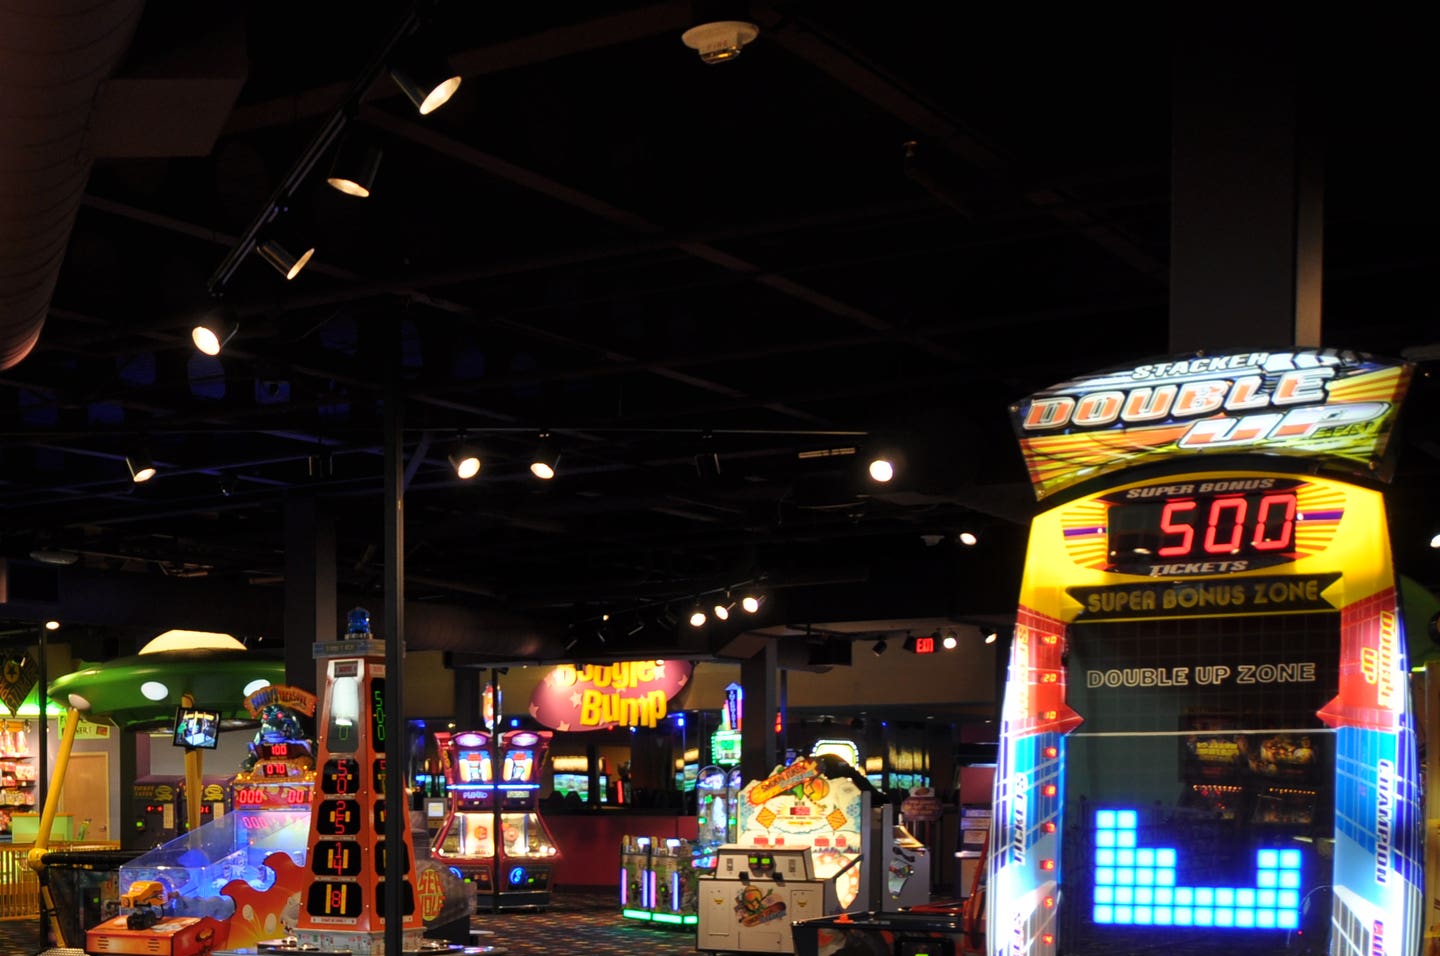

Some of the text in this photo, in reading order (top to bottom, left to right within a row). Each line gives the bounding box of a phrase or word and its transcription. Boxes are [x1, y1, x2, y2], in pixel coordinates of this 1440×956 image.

[1131, 353, 1267, 380] STACKER
[1022, 367, 1335, 430] DOUBLE
[1177, 401, 1393, 449] UP
[1126, 479, 1276, 499] SUPER BONUS
[1157, 493, 1297, 556] 500
[1149, 560, 1249, 577] TICKETS
[1088, 580, 1319, 613] SUPER BONUS ZONE
[1087, 662, 1316, 688] DOUBLE UP ZONE
[1361, 647, 1378, 685] UP
[579, 689, 667, 728] Bump
